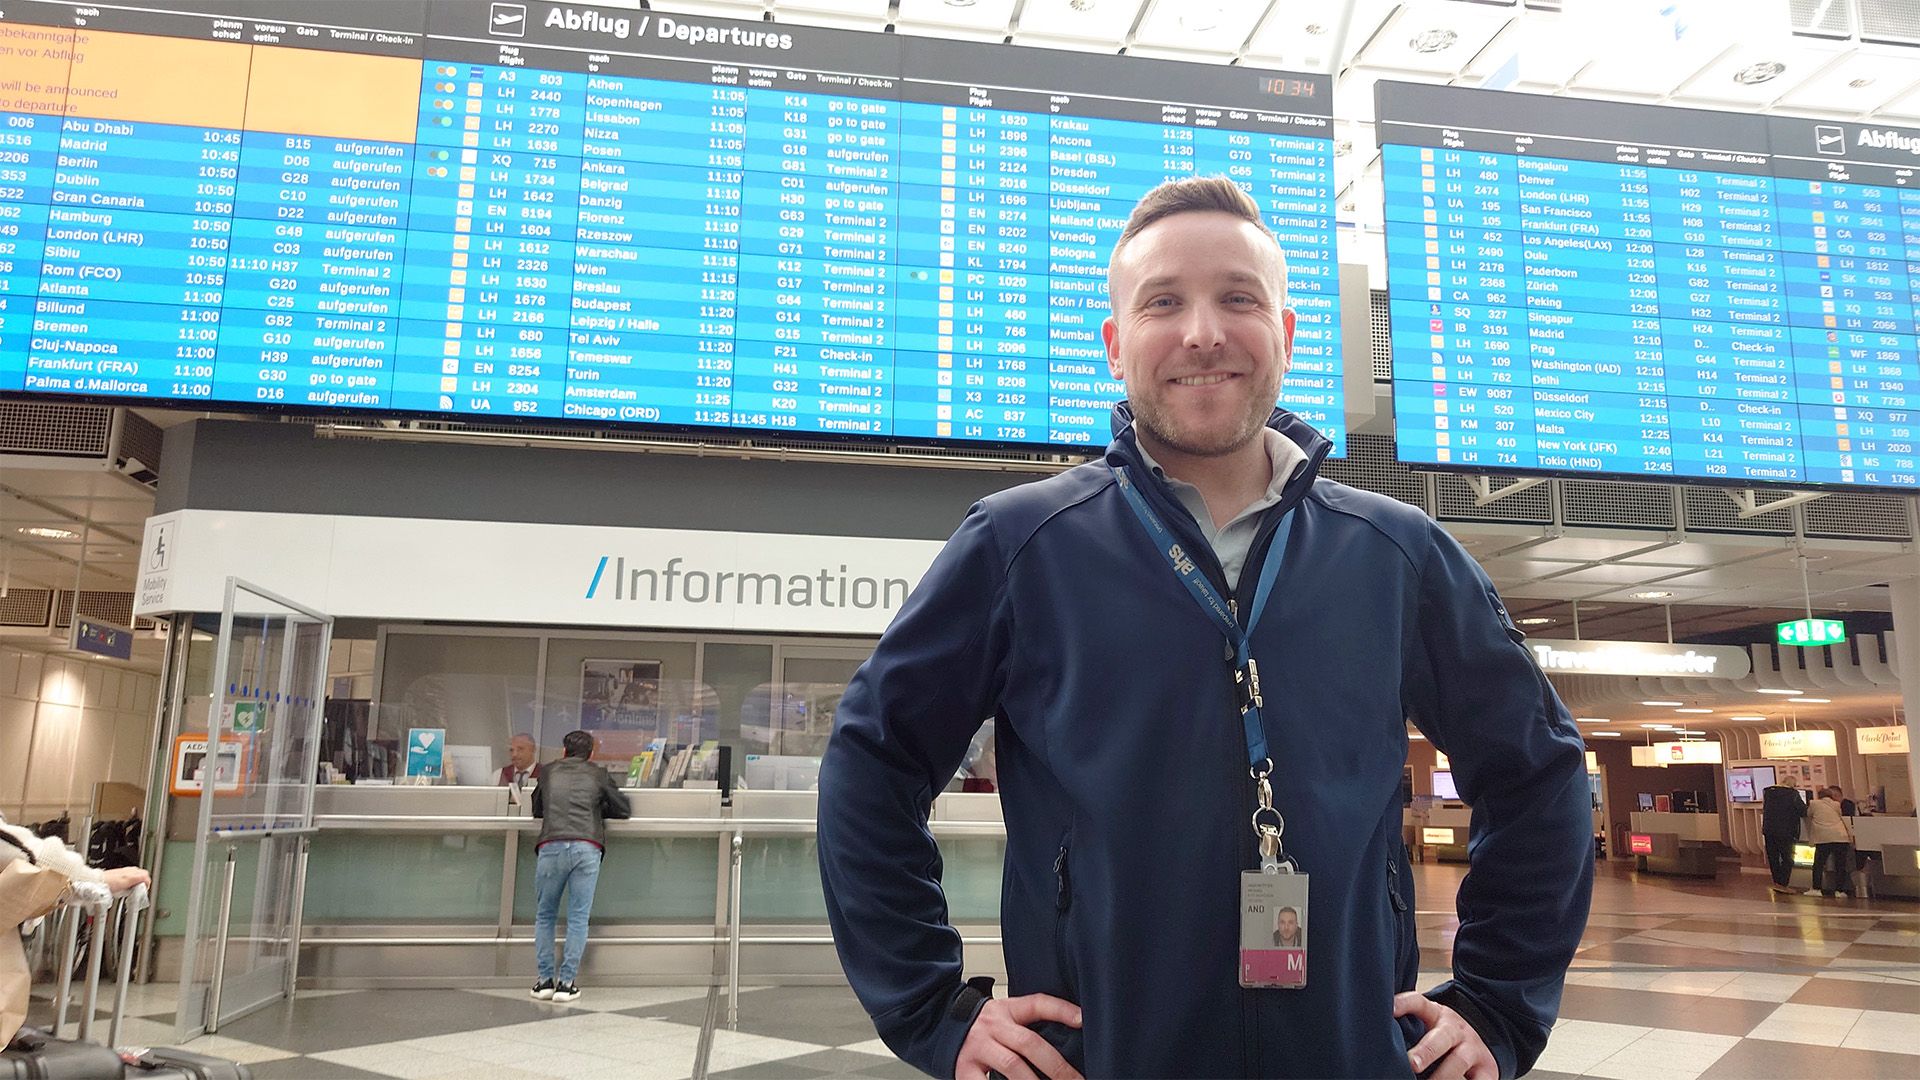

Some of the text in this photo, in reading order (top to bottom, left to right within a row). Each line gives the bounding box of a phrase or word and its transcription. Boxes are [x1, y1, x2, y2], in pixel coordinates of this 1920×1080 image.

[296, 26, 319, 37] Gate
[329, 29, 369, 41] Terminal
[375, 33, 415, 46] Check-in
[544, 7, 793, 50] Abflug / Departures
[18, 48, 37, 57] vor
[42, 48, 85, 64] Abflug
[1, 81, 118, 99] will be announced
[587, 78, 624, 91] Athen
[14, 99, 78, 113] departure
[586, 94, 663, 112] Kopenhagen
[585, 111, 641, 126] Lissabon
[1050, 118, 1090, 132] Krakau
[9, 117, 404, 157] 006 Abu Dhabi 10:45 B15 aufgerufen
[584, 127, 619, 141] Nizza
[1049, 134, 1092, 148] Ancona
[1857, 129, 1920, 155] Abflug
[59, 137, 402, 174] Madrid 10:45 D06 aufgerufen
[583, 143, 622, 157] Posen
[1050, 150, 1117, 166] Basel (BSL)
[57, 154, 309, 185] Berlin 10:50 G28
[581, 161, 625, 175] Ankara
[1050, 165, 1097, 179] Dresden
[1517, 159, 1569, 173] Bengaluru
[54, 171, 307, 202] Dublin C10
[580, 177, 629, 193] Belgrad
[1518, 173, 1555, 186] Denver
[1049, 180, 1111, 196] Düsseldorf
[52, 190, 145, 208] Gran Canaria
[579, 194, 623, 210] Danzig
[1049, 197, 1101, 212] Ljubljana
[1518, 188, 1590, 206] London (LHR)
[49, 208, 113, 227] Hamburg
[578, 210, 625, 225] Florenz
[1520, 203, 1593, 219] San Francisco
[576, 227, 633, 243] Rzeszow
[1520, 218, 1600, 237] Frankfurt (FRA)
[46, 227, 301, 255] London (LHR) C03
[1049, 229, 1097, 246] Venedig
[1522, 234, 1613, 253] Los Angeles(LAX)
[575, 245, 639, 261] Warschau
[1049, 245, 1097, 261] Bologna
[1523, 249, 1549, 261] Oulu
[44, 245, 392, 279] Sibiu 10:50 11:10 H37 Terminal 2
[574, 263, 607, 276] Wien
[41, 263, 224, 287] Rom (FCO) 10:55
[1524, 265, 1578, 279] Paderborn
[38, 281, 89, 296] Atlanta
[573, 279, 621, 294] Breslau
[1526, 280, 1559, 292] Zürich
[35, 300, 86, 315] Billund
[571, 296, 632, 313] Budapest
[1526, 295, 1563, 310] Peking
[32, 318, 89, 334] Bremen
[570, 313, 661, 332] Leipzig / Halle
[1049, 312, 1084, 325] Miami
[1527, 311, 1574, 326] Singapur
[569, 332, 621, 346] Tel Aviv
[1049, 328, 1095, 341] Mumbai
[1528, 327, 1565, 340] Madrid
[30, 337, 119, 355] Cluj-Napoca
[1530, 343, 1556, 357] Prag
[568, 349, 634, 366] Temeswar
[28, 356, 378, 388] Frankfurt (FRA) go to gate
[566, 367, 600, 381] Turin
[1049, 362, 1096, 375] Larnaka
[1531, 359, 1622, 376] Washington (IAD)
[1532, 374, 1560, 386] Delhi
[24, 373, 380, 406] Palma d.Mallorca 11:00 D16 aufgerufen
[565, 385, 638, 401] Amsterdam
[1533, 391, 1589, 404] Düsseldorf
[563, 403, 661, 423] Chicago (ORD)
[1049, 412, 1095, 426] Toronto
[1534, 407, 1596, 422] Mexico City
[1048, 429, 1091, 444] Zagreb
[1535, 423, 1566, 435] Malta
[1536, 439, 1618, 456] New York (JFK)
[1537, 455, 1603, 472] Tokio (HND)
[1287, 953, 1303, 971] M
